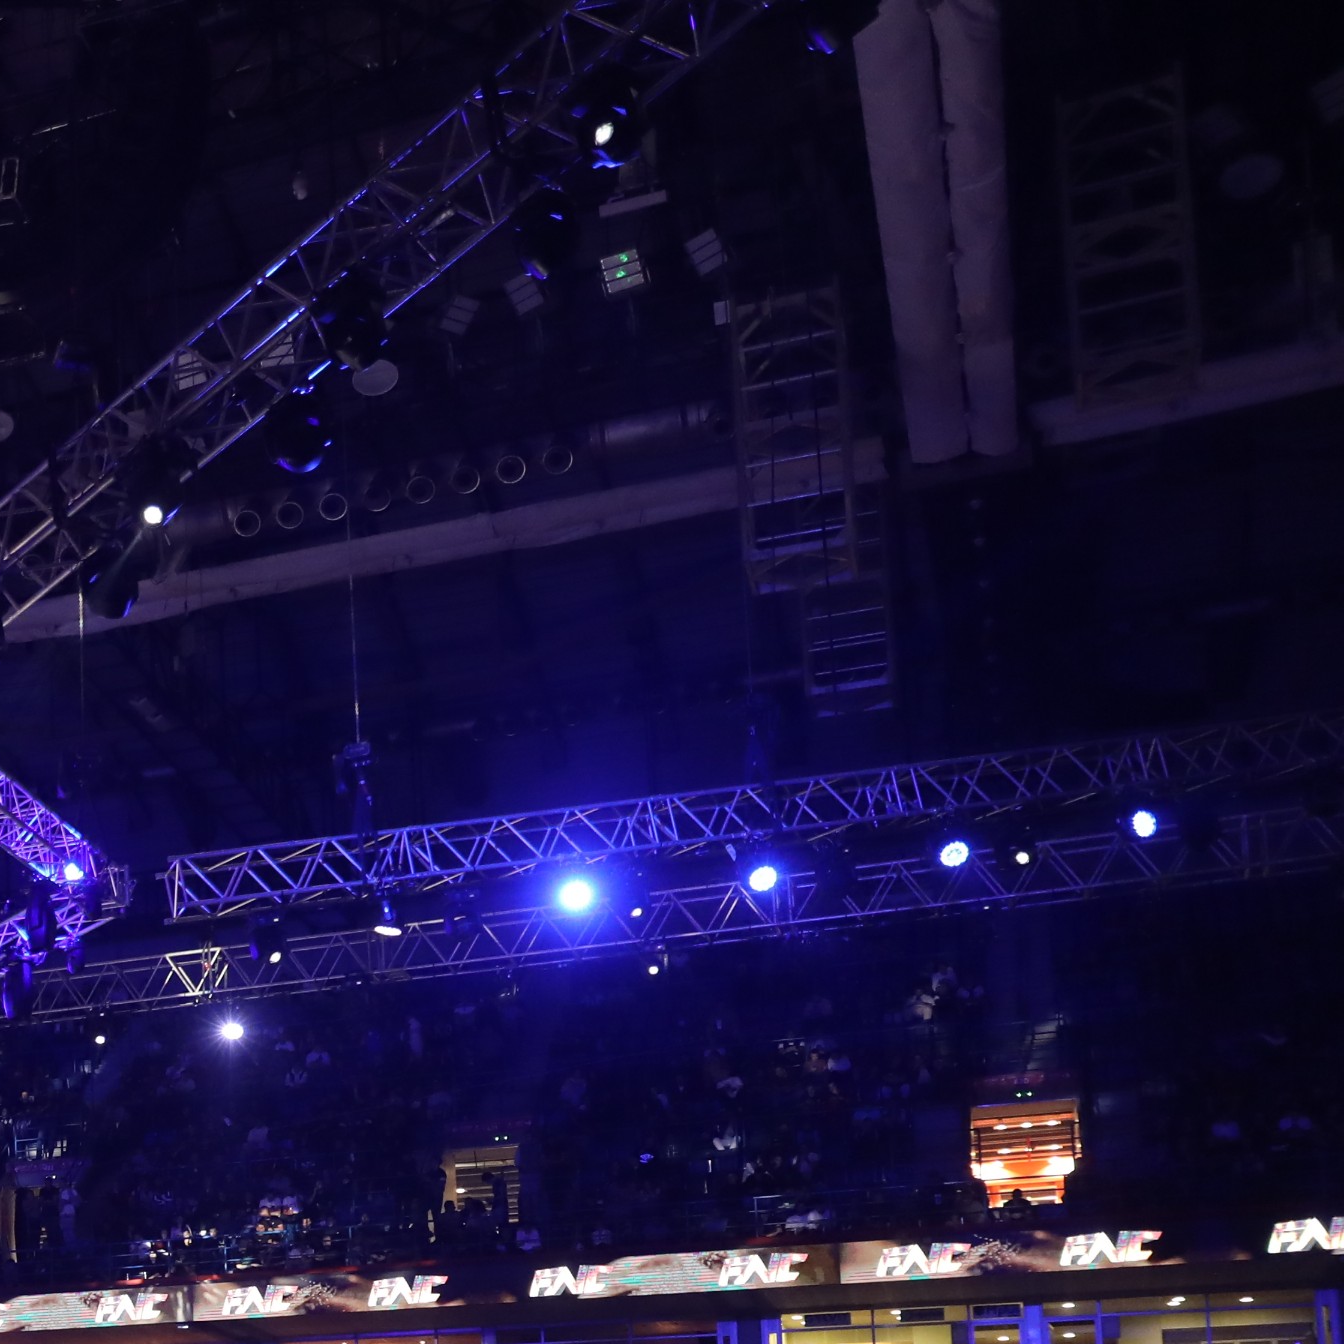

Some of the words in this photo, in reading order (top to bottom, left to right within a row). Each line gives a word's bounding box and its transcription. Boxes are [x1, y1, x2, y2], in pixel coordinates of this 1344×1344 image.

[876, 1241, 972, 1278] FNC
[1060, 1229, 1164, 1267] FNC
[529, 1264, 612, 1298] FNC
[718, 1252, 810, 1288] FNC
[221, 1284, 298, 1316] FNC
[368, 1274, 449, 1308] FNC
[94, 1292, 169, 1325] FNC
